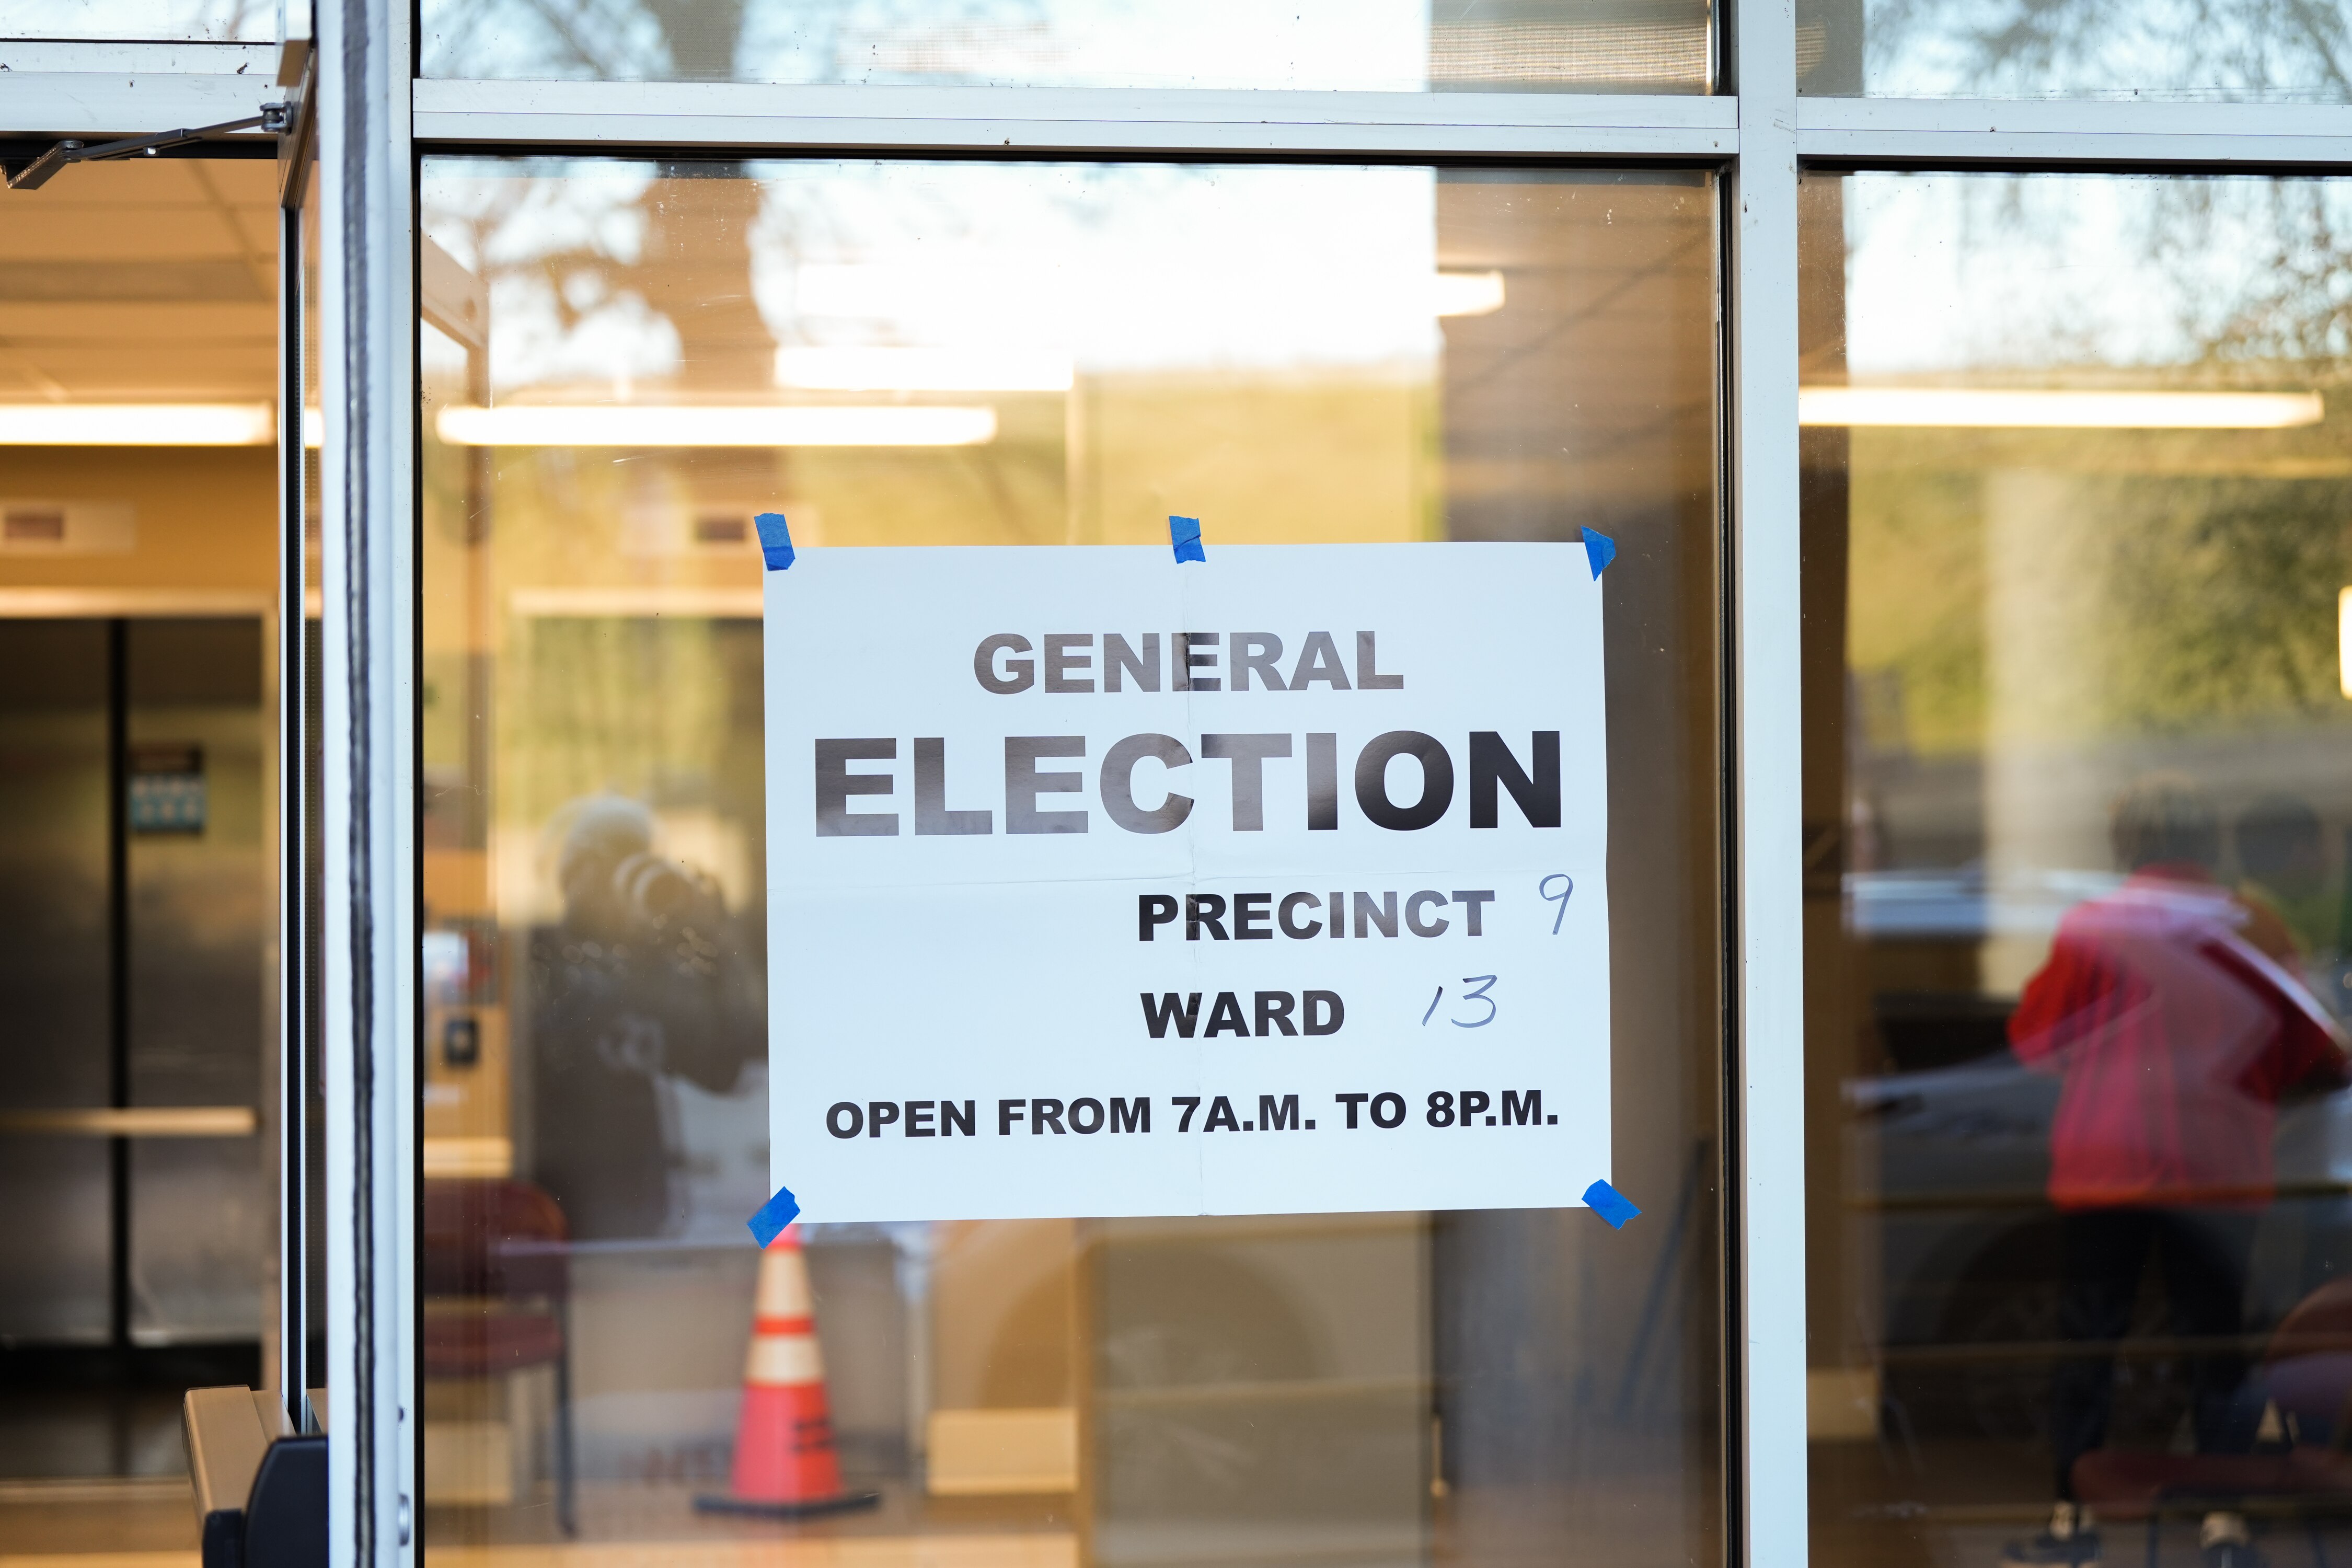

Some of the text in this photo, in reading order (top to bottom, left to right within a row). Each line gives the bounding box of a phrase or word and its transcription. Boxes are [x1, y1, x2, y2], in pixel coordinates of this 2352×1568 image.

[974, 631, 1403, 695] GENERAL
[815, 731, 1561, 837] ELECTION
[1139, 874, 1573, 941] PRECINCT 9
[1140, 975, 1497, 1038] WARD 13
[826, 1090, 1558, 1139] OPEN FROM 7A.M. TO 8P.M.
